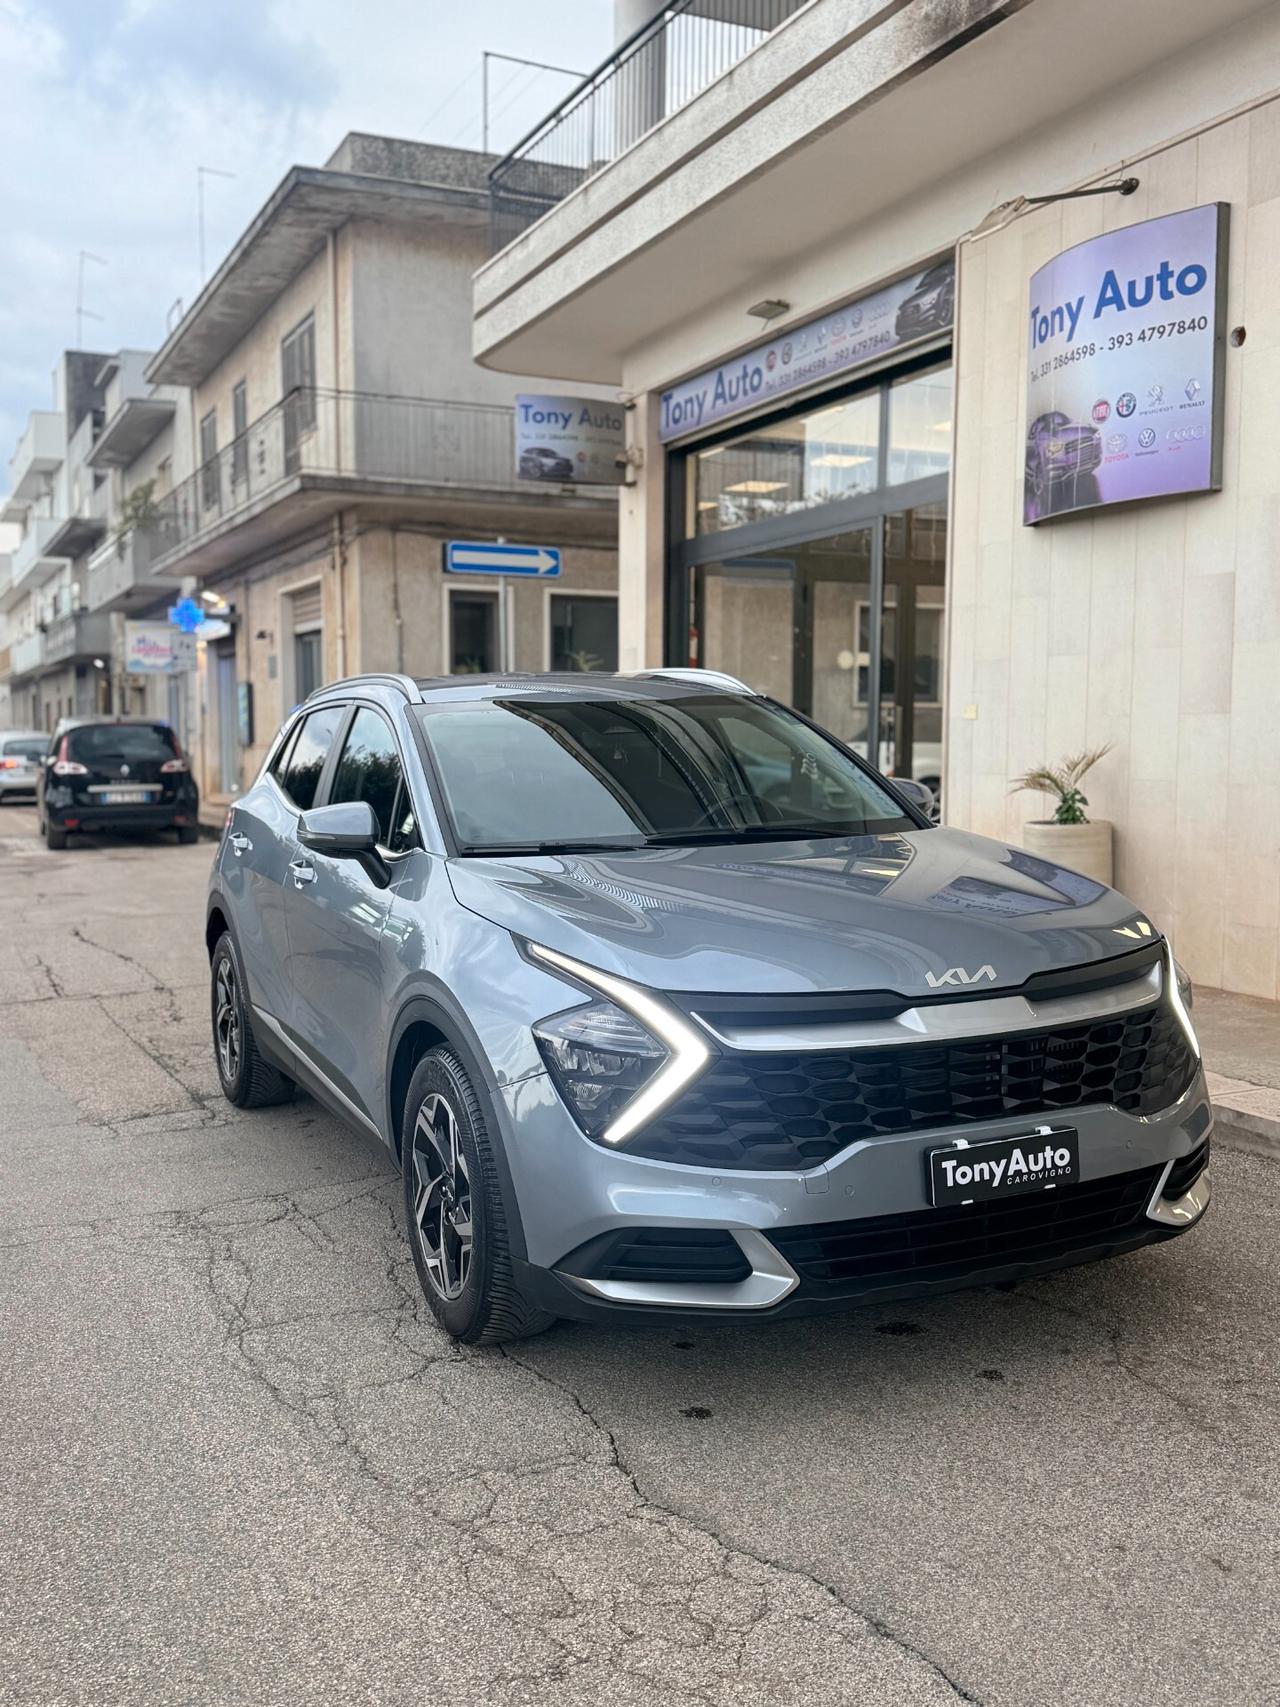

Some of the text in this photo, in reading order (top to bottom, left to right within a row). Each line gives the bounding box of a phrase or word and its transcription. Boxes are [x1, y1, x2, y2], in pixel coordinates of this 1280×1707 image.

[1031, 261, 1207, 349] Tony Auto
[1040, 361, 1051, 377] 331
[1053, 343, 1096, 371] 2864598
[1108, 332, 1133, 351] 393
[1137, 316, 1208, 343] 4797840
[520, 403, 622, 432] Tony Auto
[662, 363, 763, 429] Tony Auto
[924, 964, 998, 989] KIA
[941, 1145, 1071, 1188] TonyAuto
[1006, 1166, 1072, 1185] CAROVIGNO
